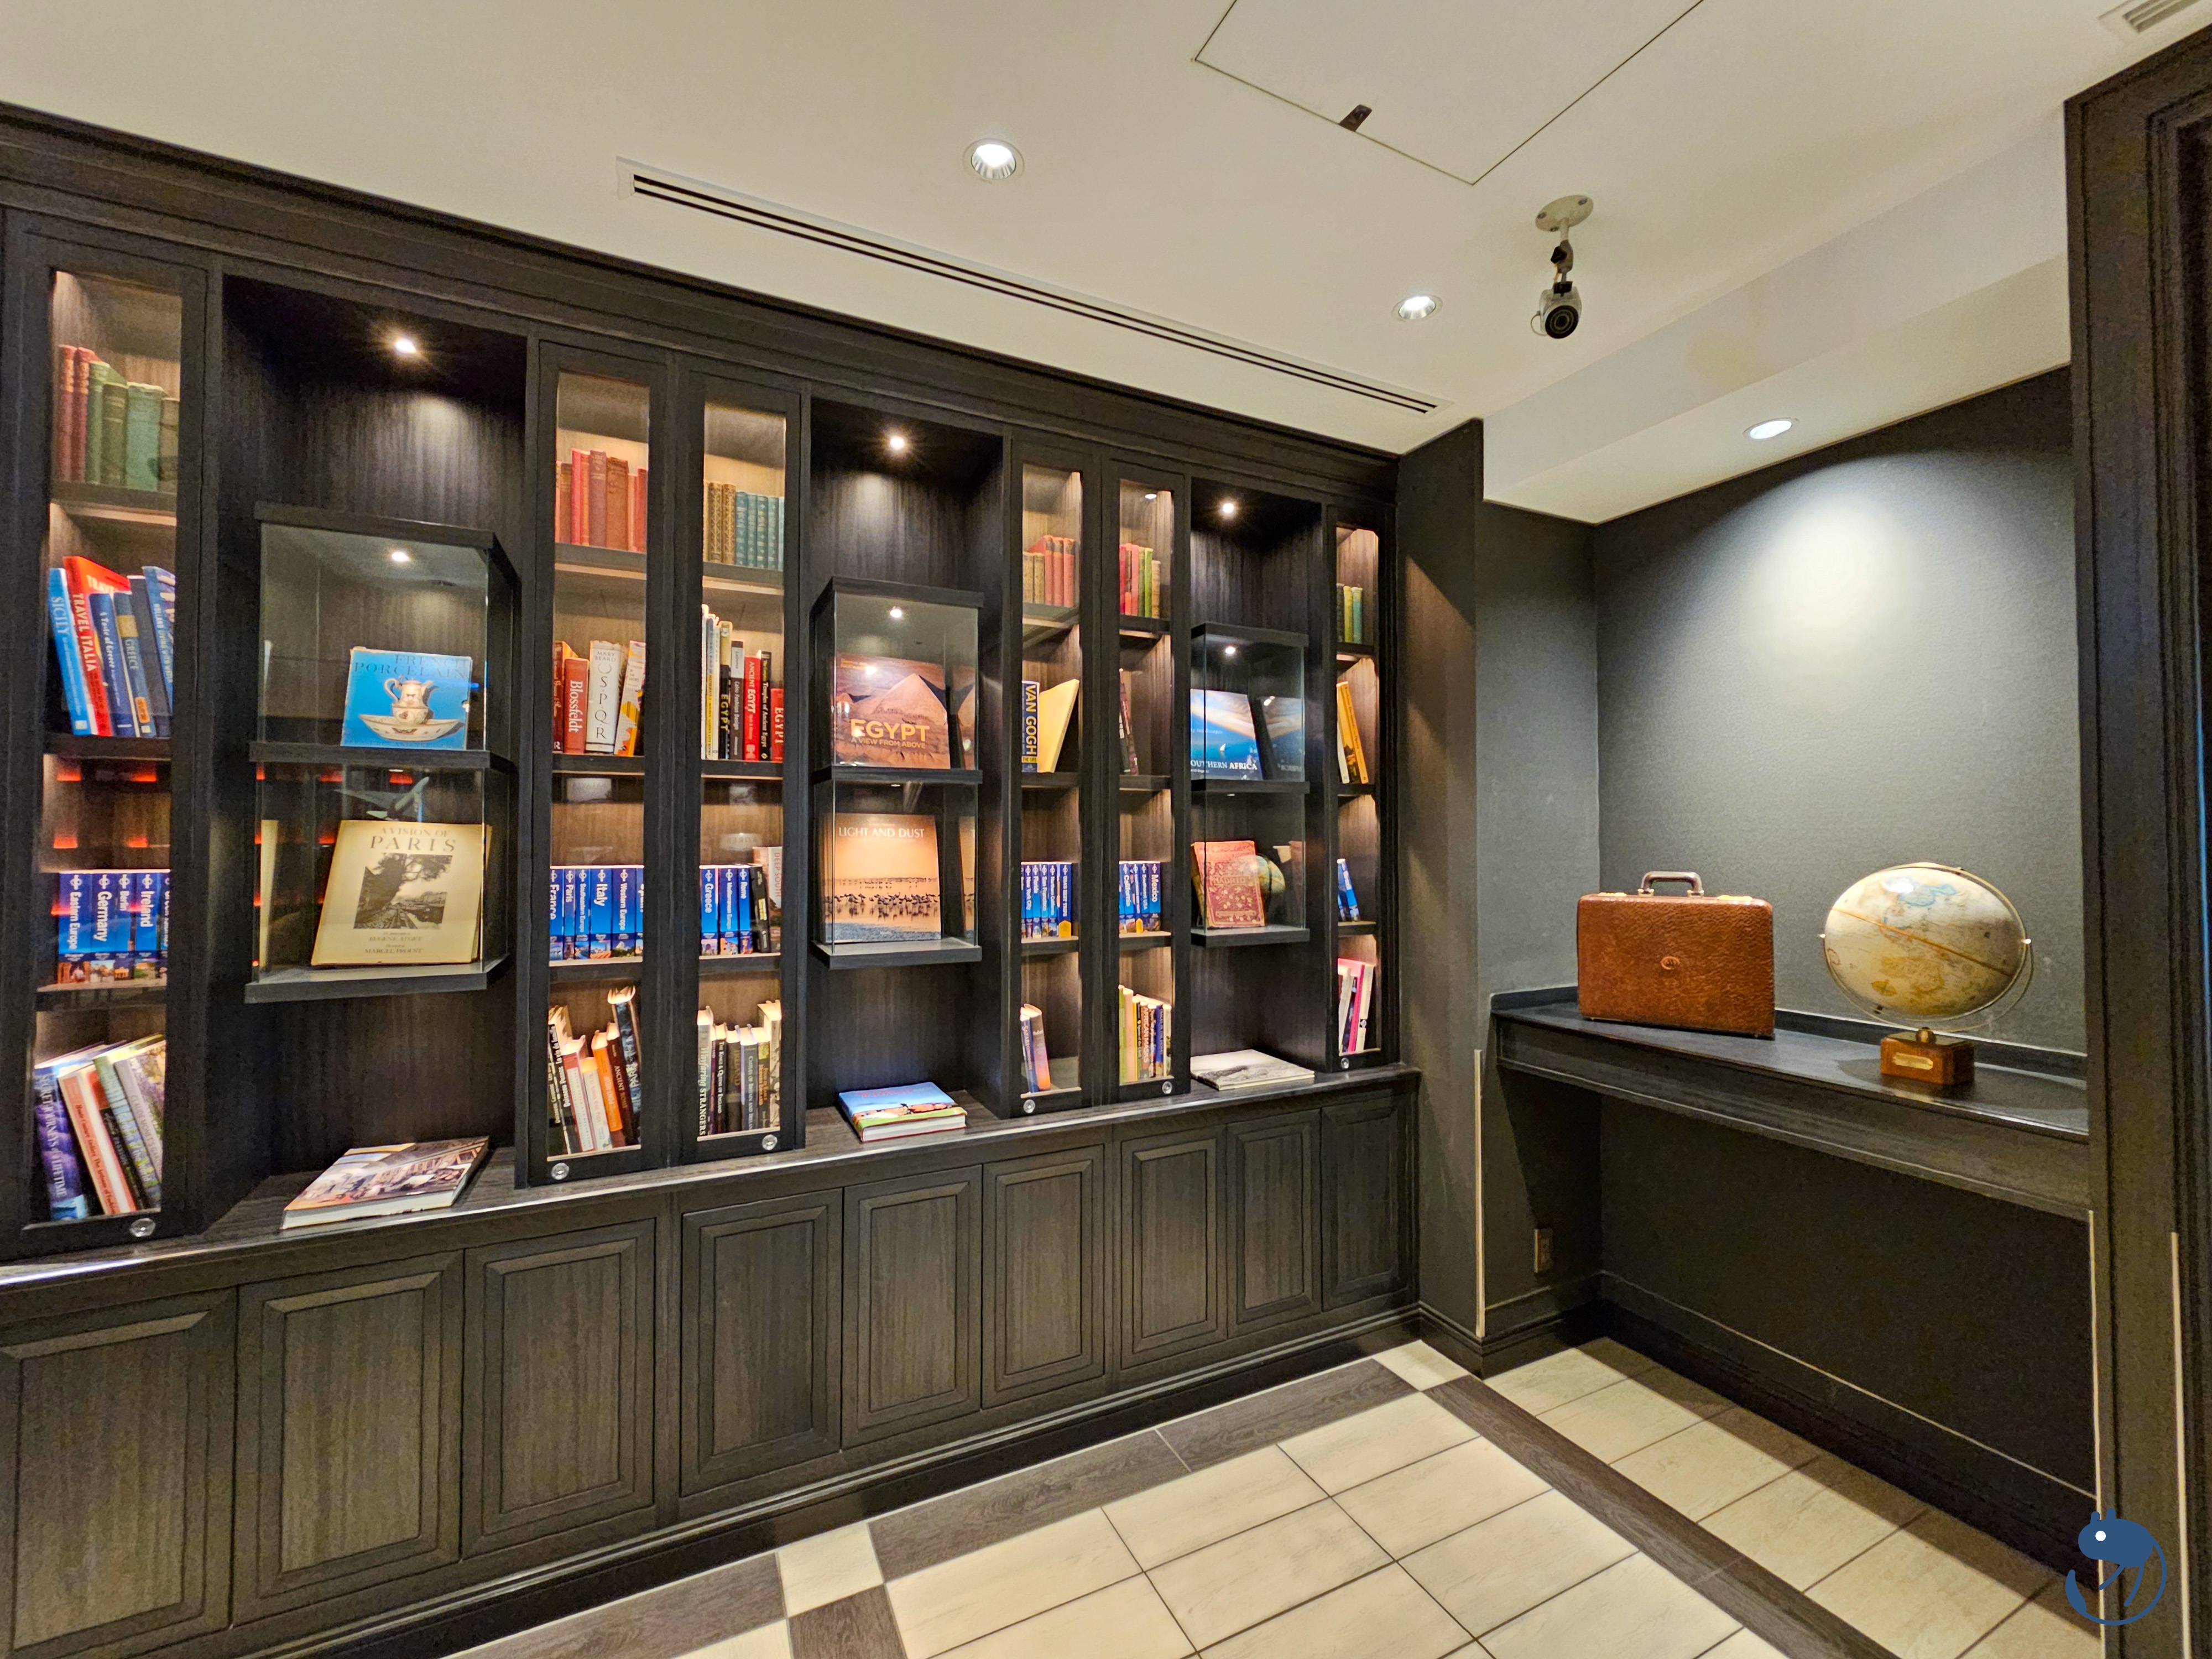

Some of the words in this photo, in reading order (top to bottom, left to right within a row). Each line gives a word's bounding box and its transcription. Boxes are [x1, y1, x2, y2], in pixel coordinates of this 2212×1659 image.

[51, 597, 70, 635] SICILY
[154, 603, 163, 628] HOLLAND
[72, 593, 88, 632] TRAVEL
[80, 636, 97, 671] ITALIA
[101, 618, 111, 635] Taste
[106, 645, 116, 668] Greece
[125, 639, 138, 670] GREECE
[395, 655, 466, 668] FRENCH
[354, 662, 465, 679] PORCELAIN
[568, 680, 583, 732] Blossfeldt
[747, 689, 756, 713] EGYPT
[1026, 685, 1036, 712] VAN
[775, 707, 784, 744] EGYPT
[851, 719, 930, 742] EGYPT
[1026, 716, 1036, 755] GOGH
[1191, 760, 1227, 769] OUTHERN
[1229, 761, 1258, 770] AFRICA
[369, 836, 457, 852] PARIS
[390, 827, 430, 836] VISION
[839, 827, 868, 837] LIGHT
[871, 828, 895, 837] AND
[899, 828, 925, 838] DUST
[70, 891, 81, 921] Eastern
[119, 891, 129, 911] Berlin
[550, 884, 560, 920] France
[566, 884, 574, 902] Paris
[593, 884, 608, 906] Italy
[705, 883, 714, 913] Greece
[93, 891, 112, 941] Germany
[140, 891, 155, 927] Ireland
[619, 909, 627, 931] Europe
[67, 922, 80, 949] Europe
[614, 1065, 624, 1091] ANCIENT
[697, 1047, 709, 1087] Wayfaring
[51, 1160, 67, 1197] LIFETIME
